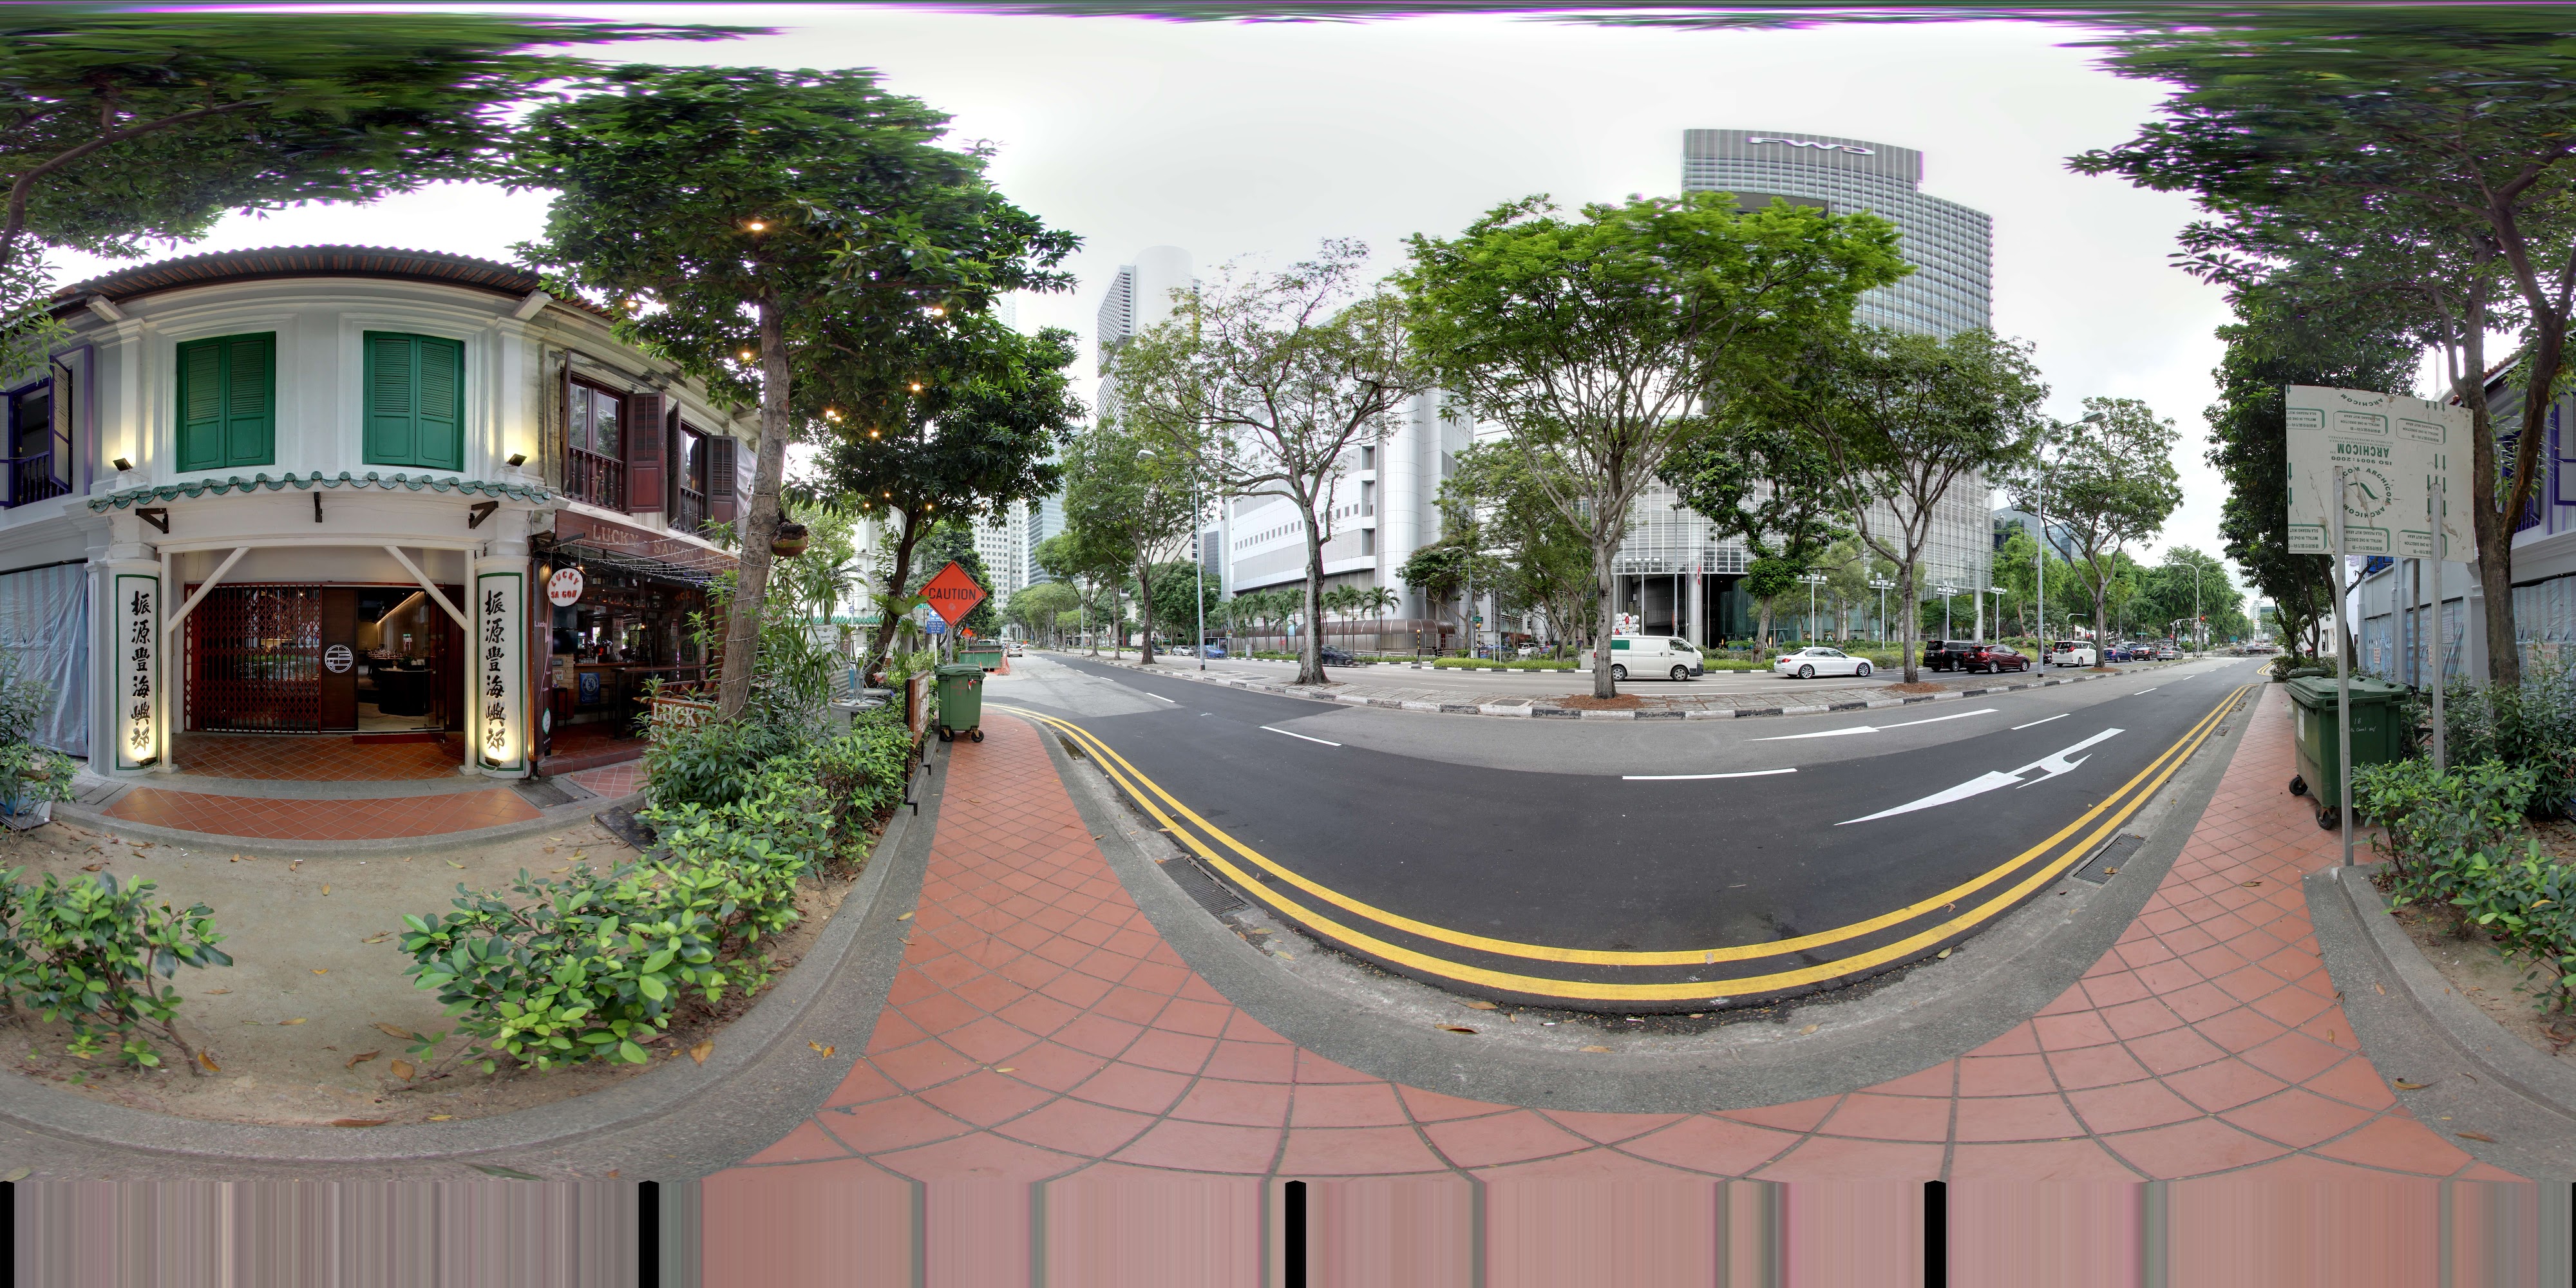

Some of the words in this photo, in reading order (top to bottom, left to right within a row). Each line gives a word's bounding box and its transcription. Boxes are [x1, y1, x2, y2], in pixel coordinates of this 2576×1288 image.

[2340, 393, 2383, 406] ARCHICOM
[2337, 443, 2389, 459] ARCHICOM
[592, 524, 639, 548] LUCKY
[654, 541, 694, 562] SAIGON
[551, 571, 578, 587] LUCKY
[929, 587, 976, 600] CAUTION
